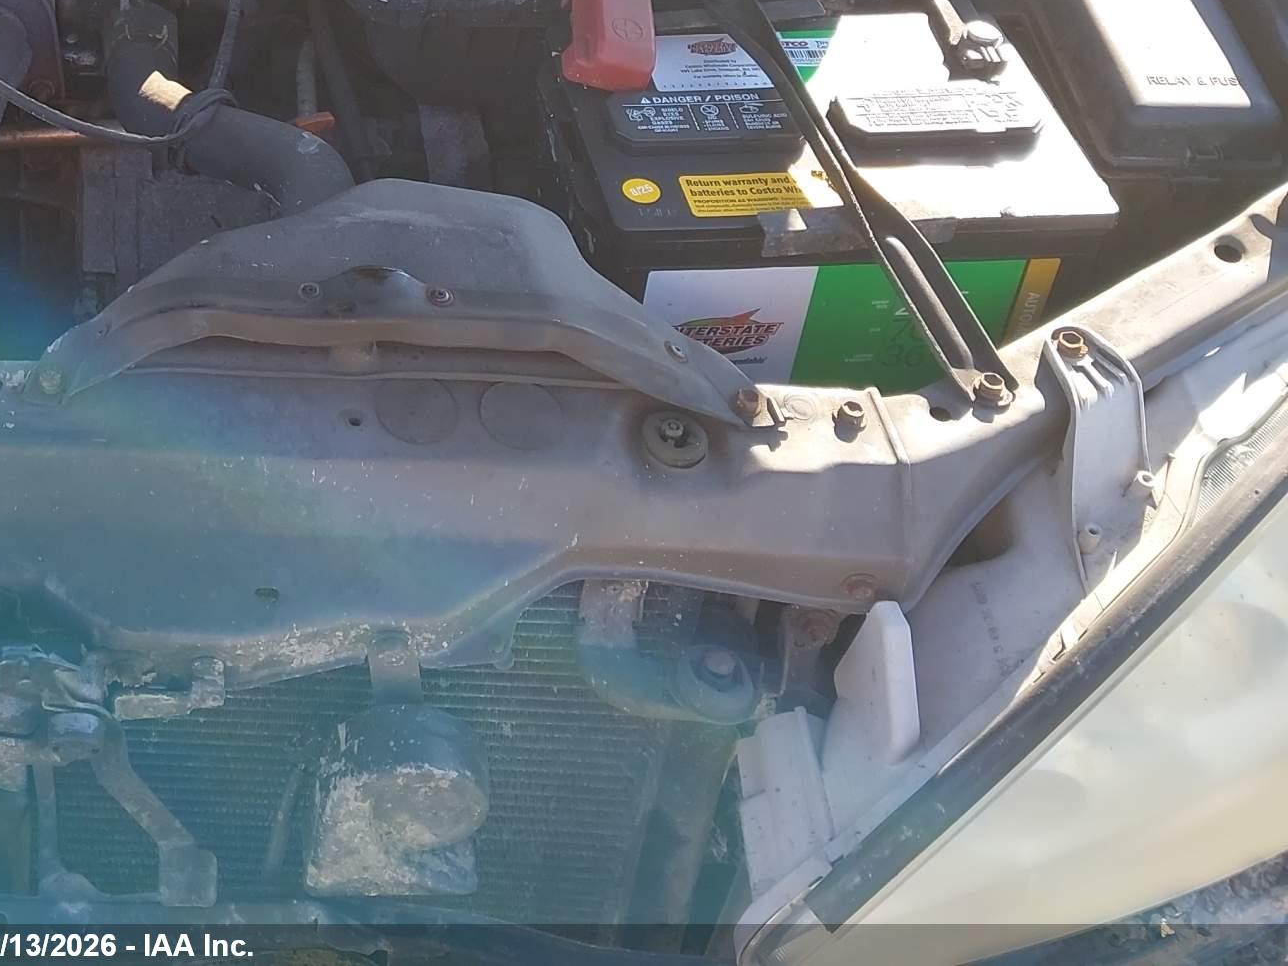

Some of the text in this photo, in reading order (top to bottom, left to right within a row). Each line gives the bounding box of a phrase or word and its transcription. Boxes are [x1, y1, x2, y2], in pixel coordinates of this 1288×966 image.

[1146, 75, 1191, 86] RELAY
[1209, 76, 1240, 86] FUS
[652, 95, 703, 104] DANGER
[714, 92, 760, 102] POISON
[685, 175, 790, 188] Return warranty and
[689, 186, 735, 197] batteries
[737, 188, 747, 196] to
[749, 186, 783, 196] Costco
